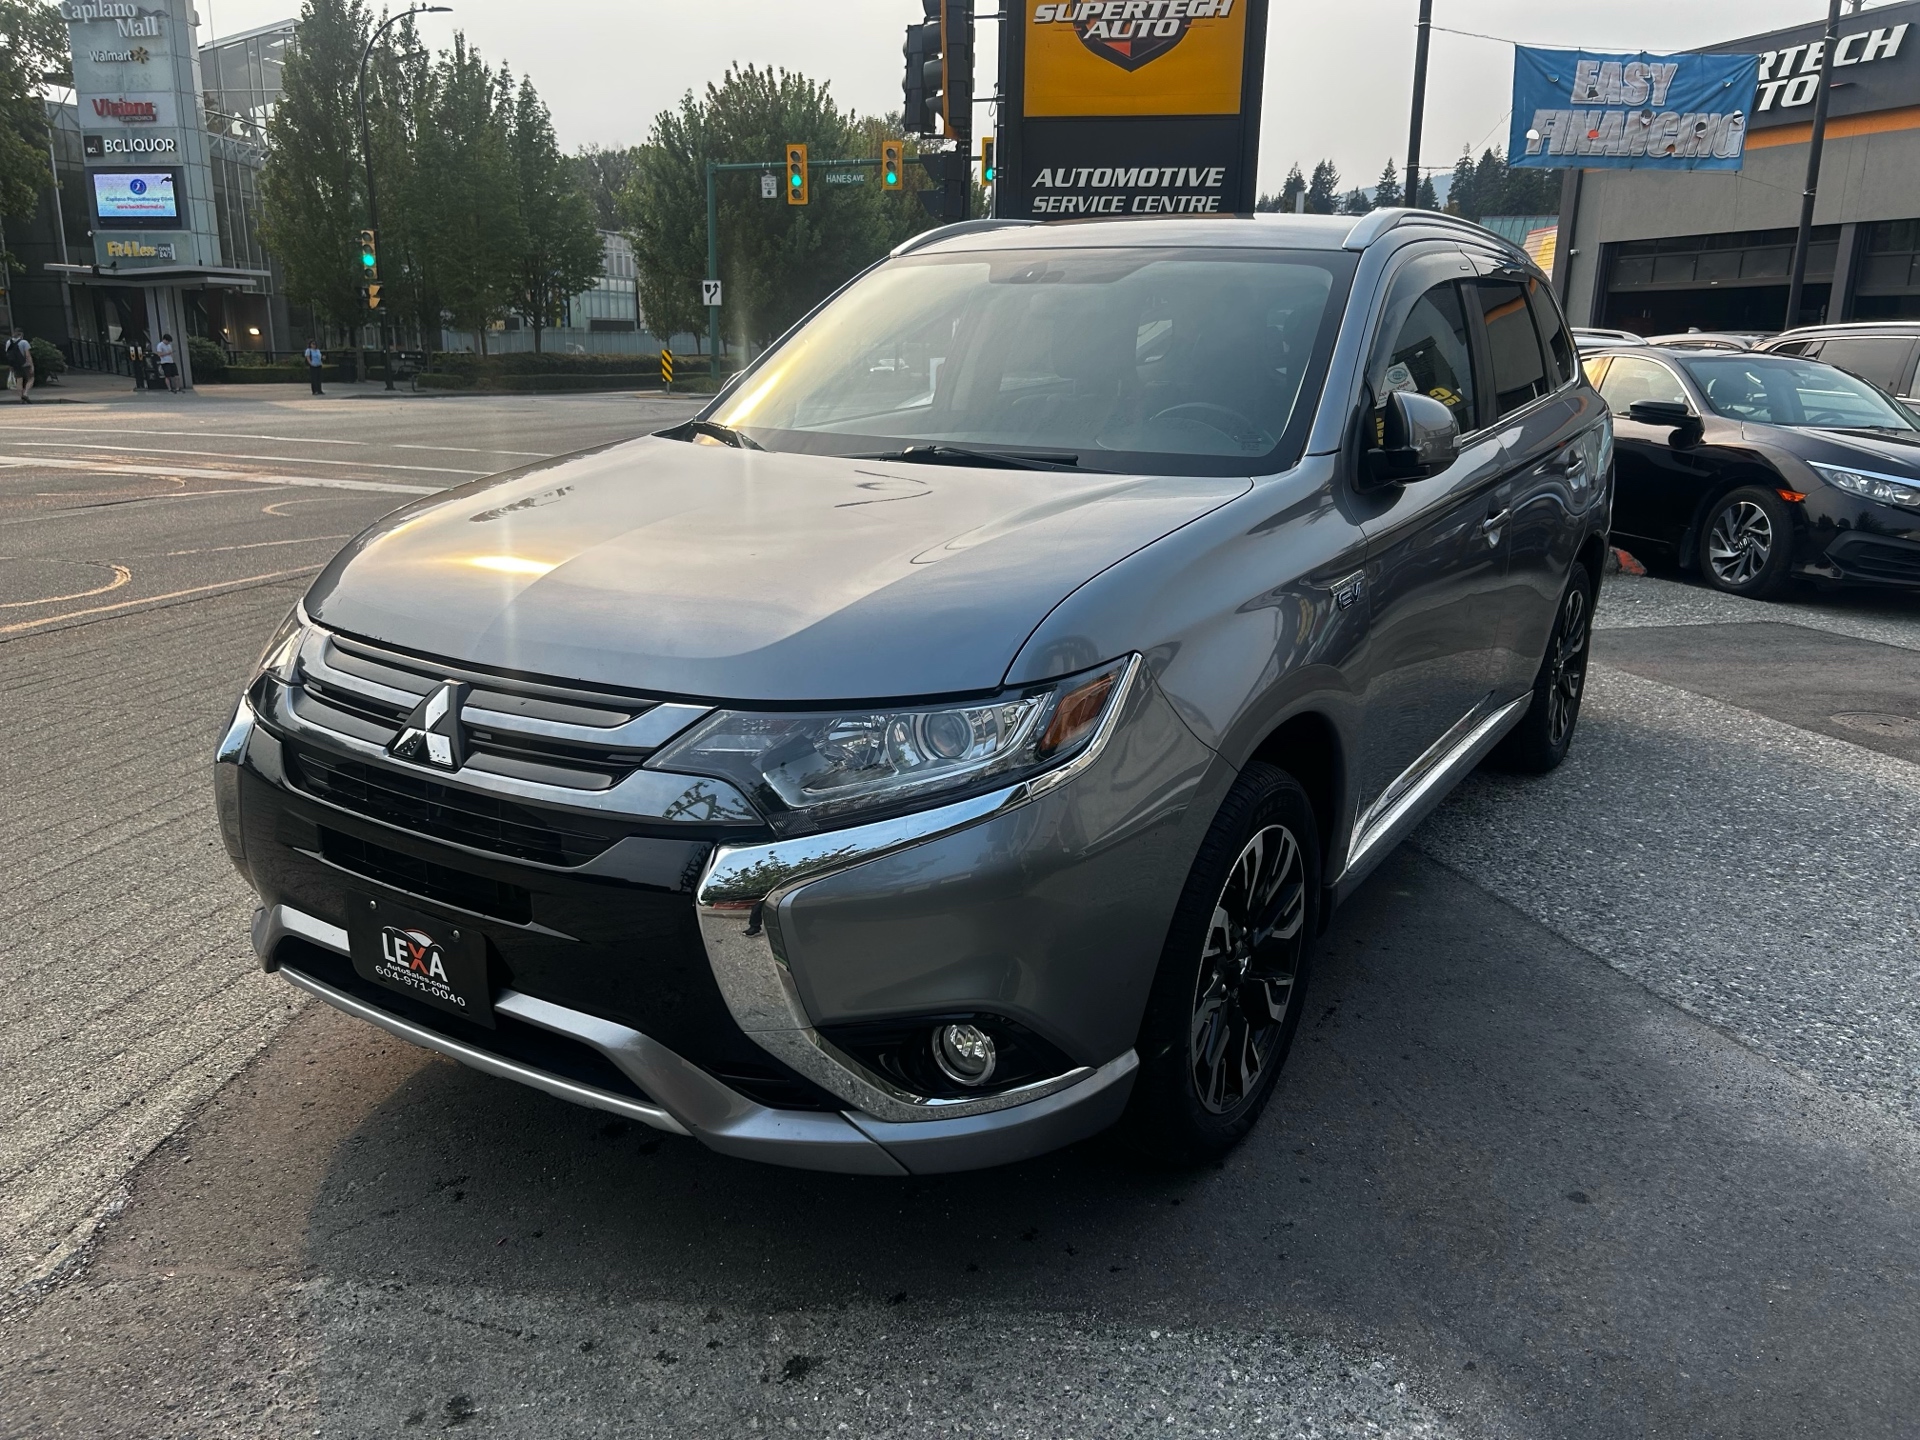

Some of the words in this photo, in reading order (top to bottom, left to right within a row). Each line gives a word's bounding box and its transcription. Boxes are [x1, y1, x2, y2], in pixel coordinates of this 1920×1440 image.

[60, 0, 136, 24] Capilano
[1033, 0, 1234, 23] SUPERTECH
[115, 16, 160, 37] Mall
[1083, 19, 1180, 39] AUTO
[89, 50, 133, 62] Walmart
[1571, 59, 1678, 106] EASY
[1757, 74, 1820, 111] TO
[91, 98, 155, 116] Visions
[1526, 109, 1746, 158] FINANCING
[826, 174, 852, 183] HANES
[852, 174, 865, 182] AVE
[1031, 167, 1225, 188] AUTOMOTIVE
[1032, 196, 1126, 213] SERVICE
[1131, 195, 1222, 213] CENTRE
[382, 932, 448, 983] LEXA
[375, 965, 466, 1007] 604-971-0040
[387, 963, 450, 991] AutoSales.com
